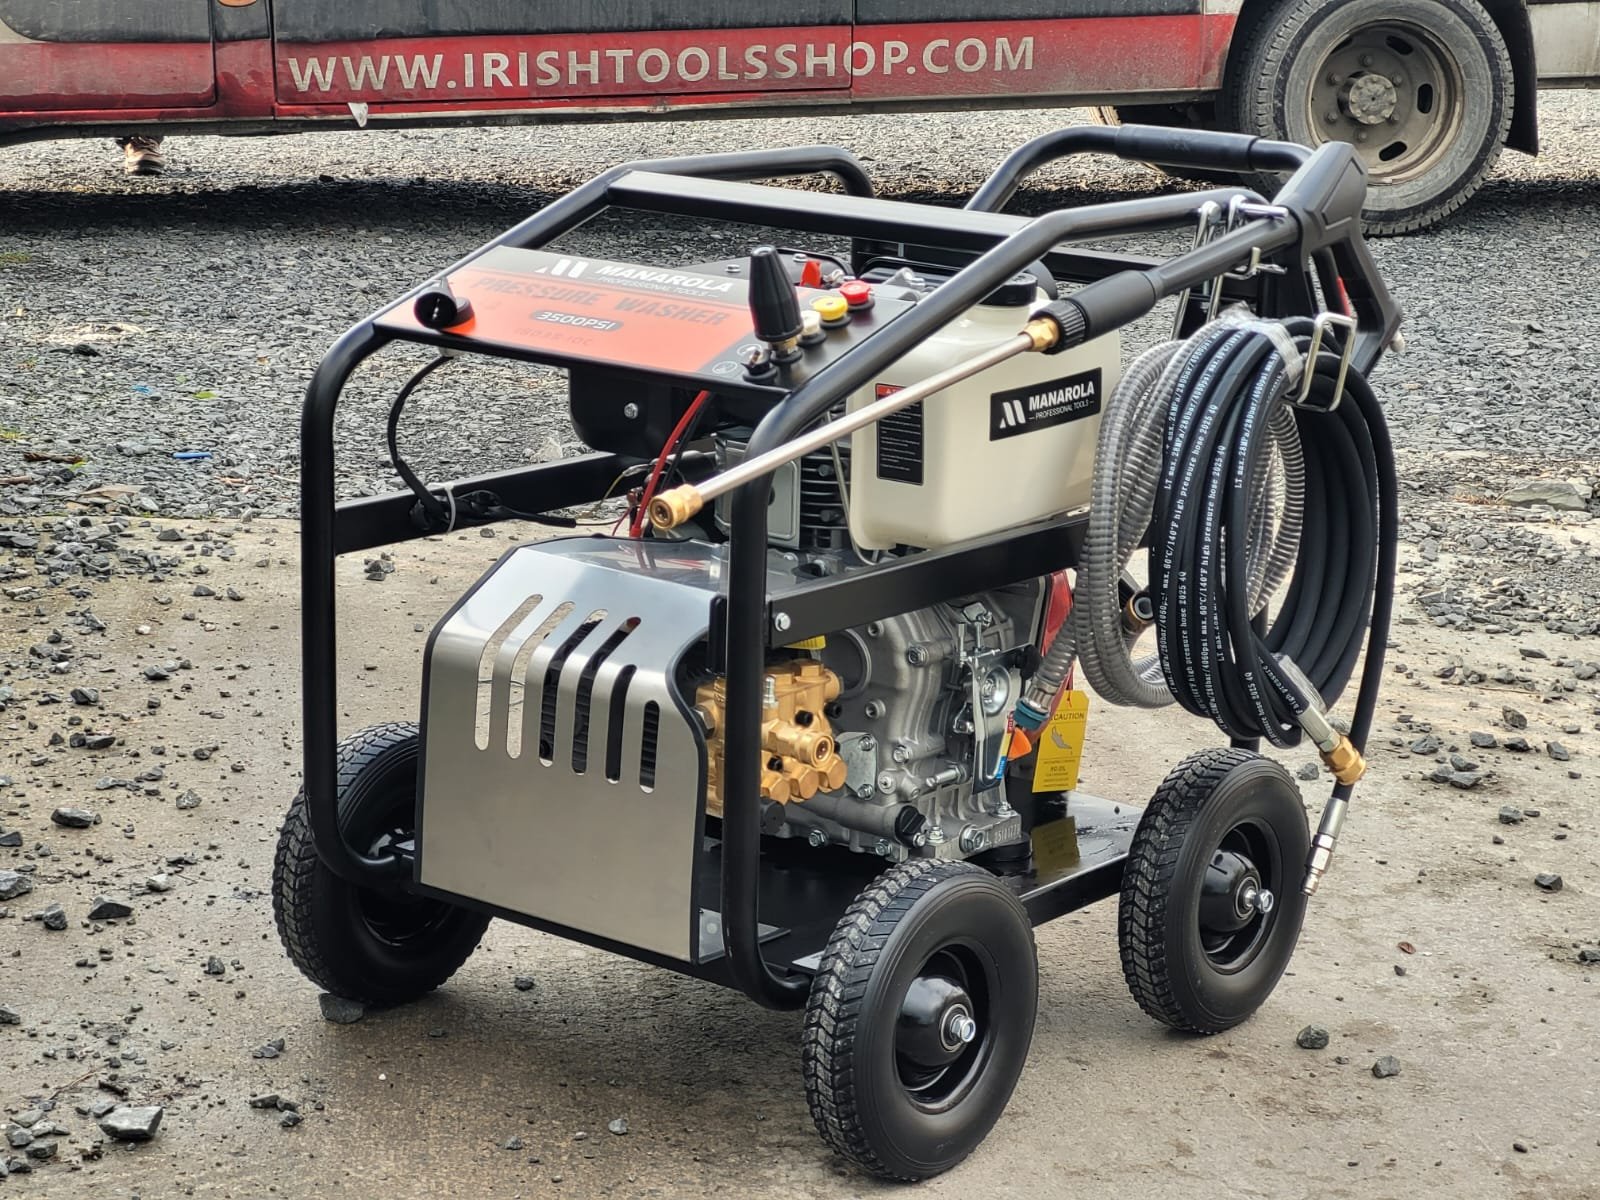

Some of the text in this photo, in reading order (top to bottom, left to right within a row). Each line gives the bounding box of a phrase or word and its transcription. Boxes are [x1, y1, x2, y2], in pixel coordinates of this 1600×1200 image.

[288, 36, 1035, 92] WWW.IRISHTOOLSSHOP.COM
[595, 266, 733, 292] MANAROLA
[470, 277, 731, 326] PRESSURE WASHER
[536, 310, 620, 331] 3500PSI
[1029, 381, 1095, 411] MANAROLA
[1036, 399, 1089, 419] PROFESSIONAL TOOLS
[1168, 458, 1178, 477] max.
[1174, 499, 1185, 519] high
[1181, 457, 1197, 497] pressure
[1192, 436, 1205, 455] hose
[1200, 415, 1213, 434] 2025
[1212, 458, 1224, 477] 2025
[1164, 479, 1173, 490] LT
[1208, 479, 1219, 499] hose
[1235, 478, 1242, 488] LT
[1203, 501, 1214, 542] pressure
[1201, 544, 1210, 566] high
[1179, 585, 1187, 605] 2025
[1263, 665, 1288, 694] pressure
[1054, 711, 1085, 721] CAUTION
